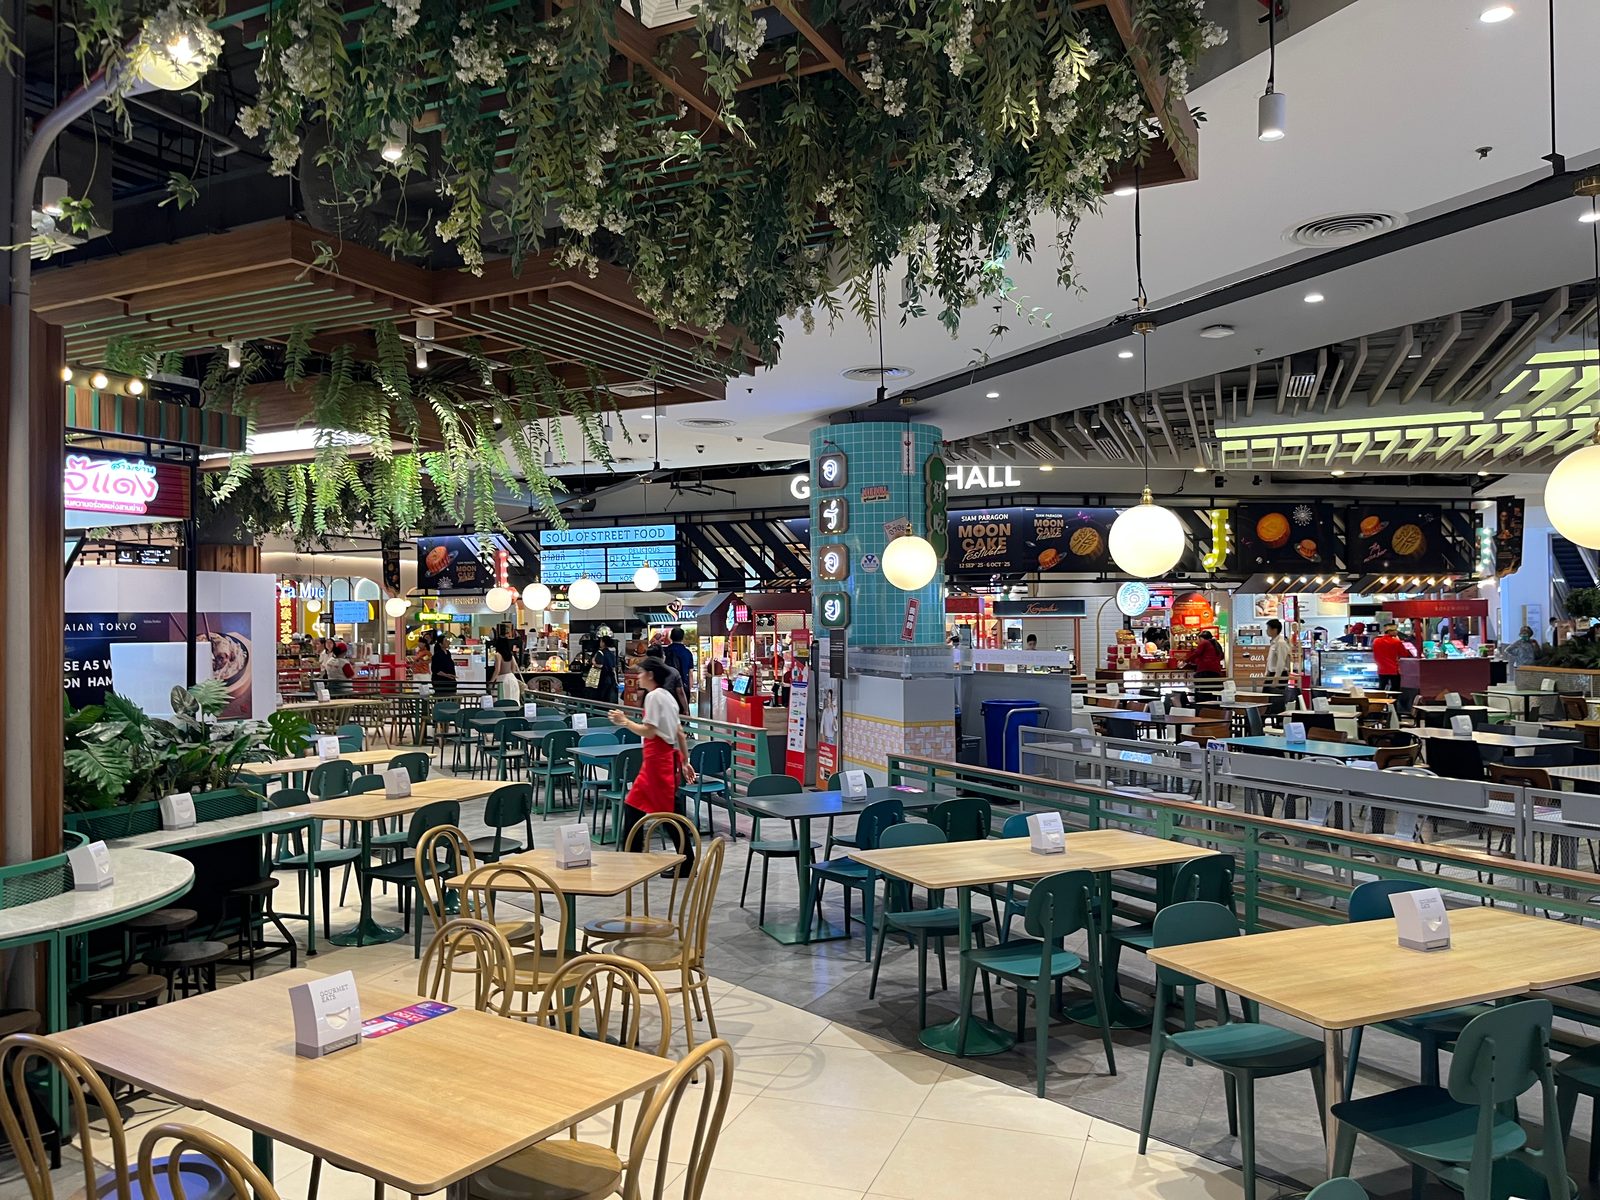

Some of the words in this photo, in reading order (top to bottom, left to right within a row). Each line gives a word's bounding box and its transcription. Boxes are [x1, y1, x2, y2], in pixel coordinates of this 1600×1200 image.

[944, 466, 1021, 490] HALL
[978, 513, 1009, 521] PARAGON
[1034, 519, 1064, 527] MOON
[546, 532, 574, 543] SOUL
[576, 532, 590, 542] OF
[592, 530, 631, 541] STREET
[634, 528, 666, 539] FOOD
[958, 523, 1011, 538] MOON
[962, 537, 1007, 552] CAKE
[99, 623, 137, 631] TOKYO
[83, 660, 99, 671] A5
[319, 983, 349, 998] GOURMET
[321, 993, 337, 1003] EATS
